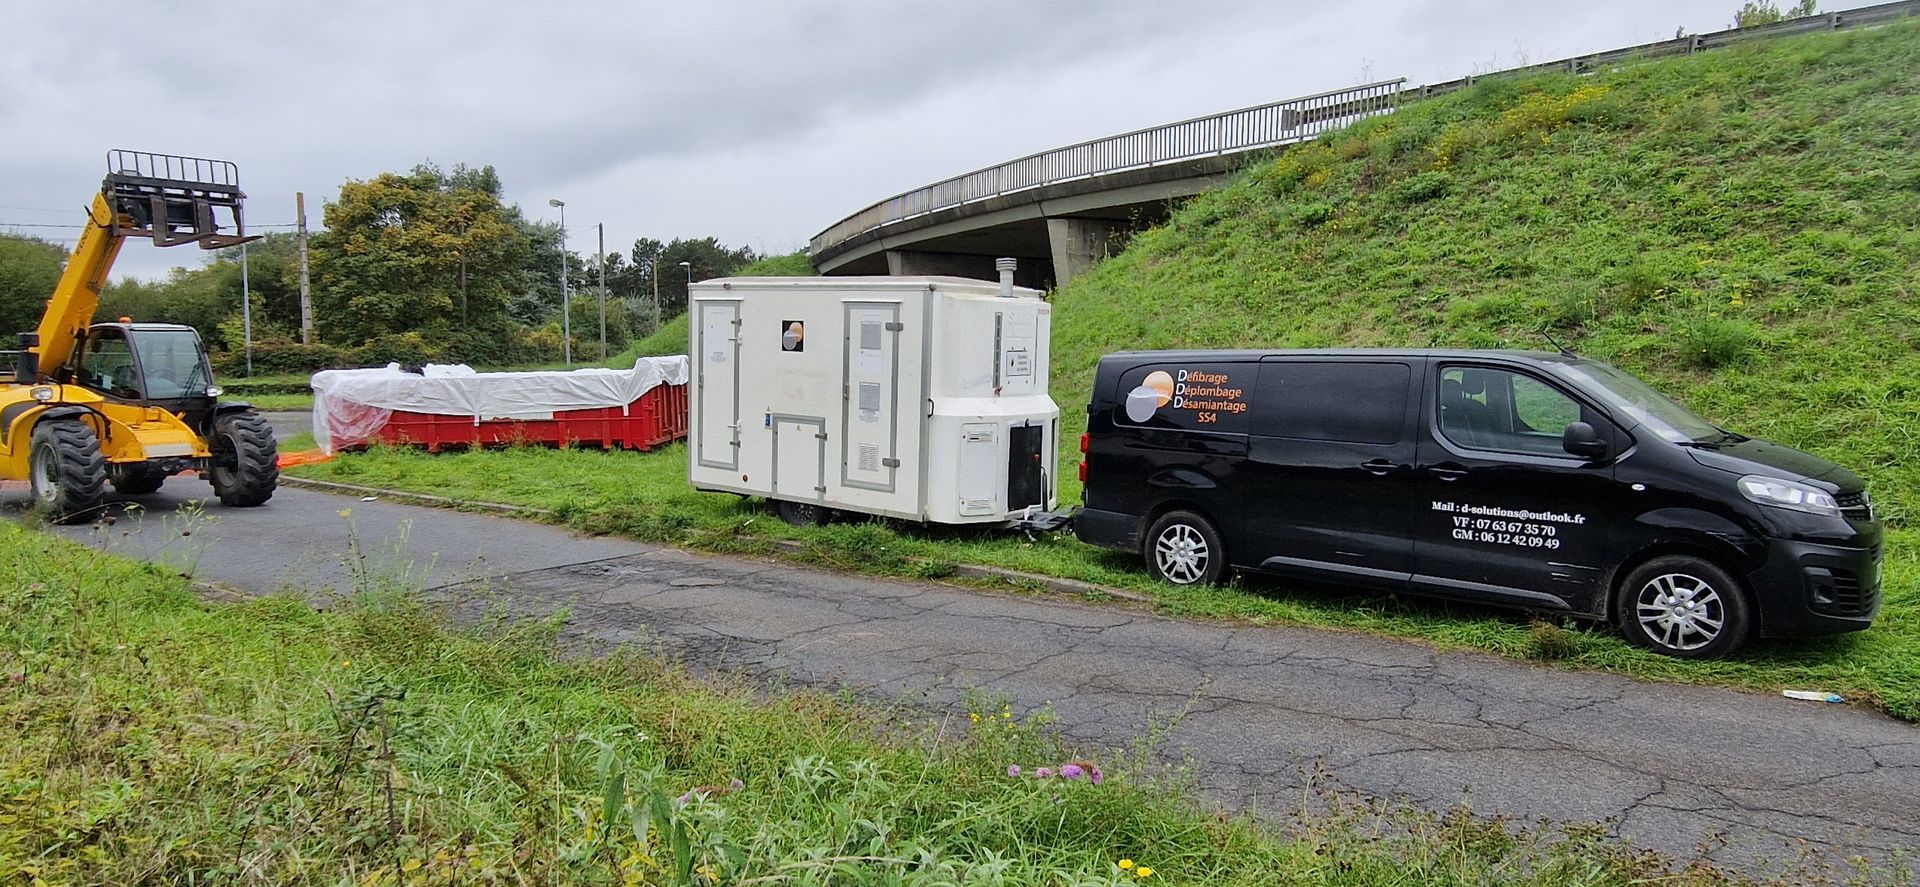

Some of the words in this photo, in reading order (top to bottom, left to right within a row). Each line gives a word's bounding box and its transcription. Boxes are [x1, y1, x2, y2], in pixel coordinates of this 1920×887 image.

[1178, 369, 1228, 384] Défibrage
[1176, 383, 1242, 399] Déplombage
[1173, 396, 1247, 413] Désamiantage
[1197, 411, 1217, 423] SS4
[1431, 501, 1454, 511] Mail
[1461, 504, 1586, 524] d-solutions@outlook.fr
[1452, 516, 1470, 527] VF
[1476, 518, 1491, 529] 07
[1492, 520, 1507, 532] 63
[1507, 522, 1523, 533] 67
[1524, 523, 1539, 535] 35
[1540, 525, 1556, 537] 70
[1452, 528, 1474, 540] GM
[1480, 531, 1495, 542] 06
[1496, 532, 1511, 544] 12
[1512, 534, 1527, 546] 42
[1528, 536, 1543, 548] 09
[1544, 538, 1560, 549] 49
